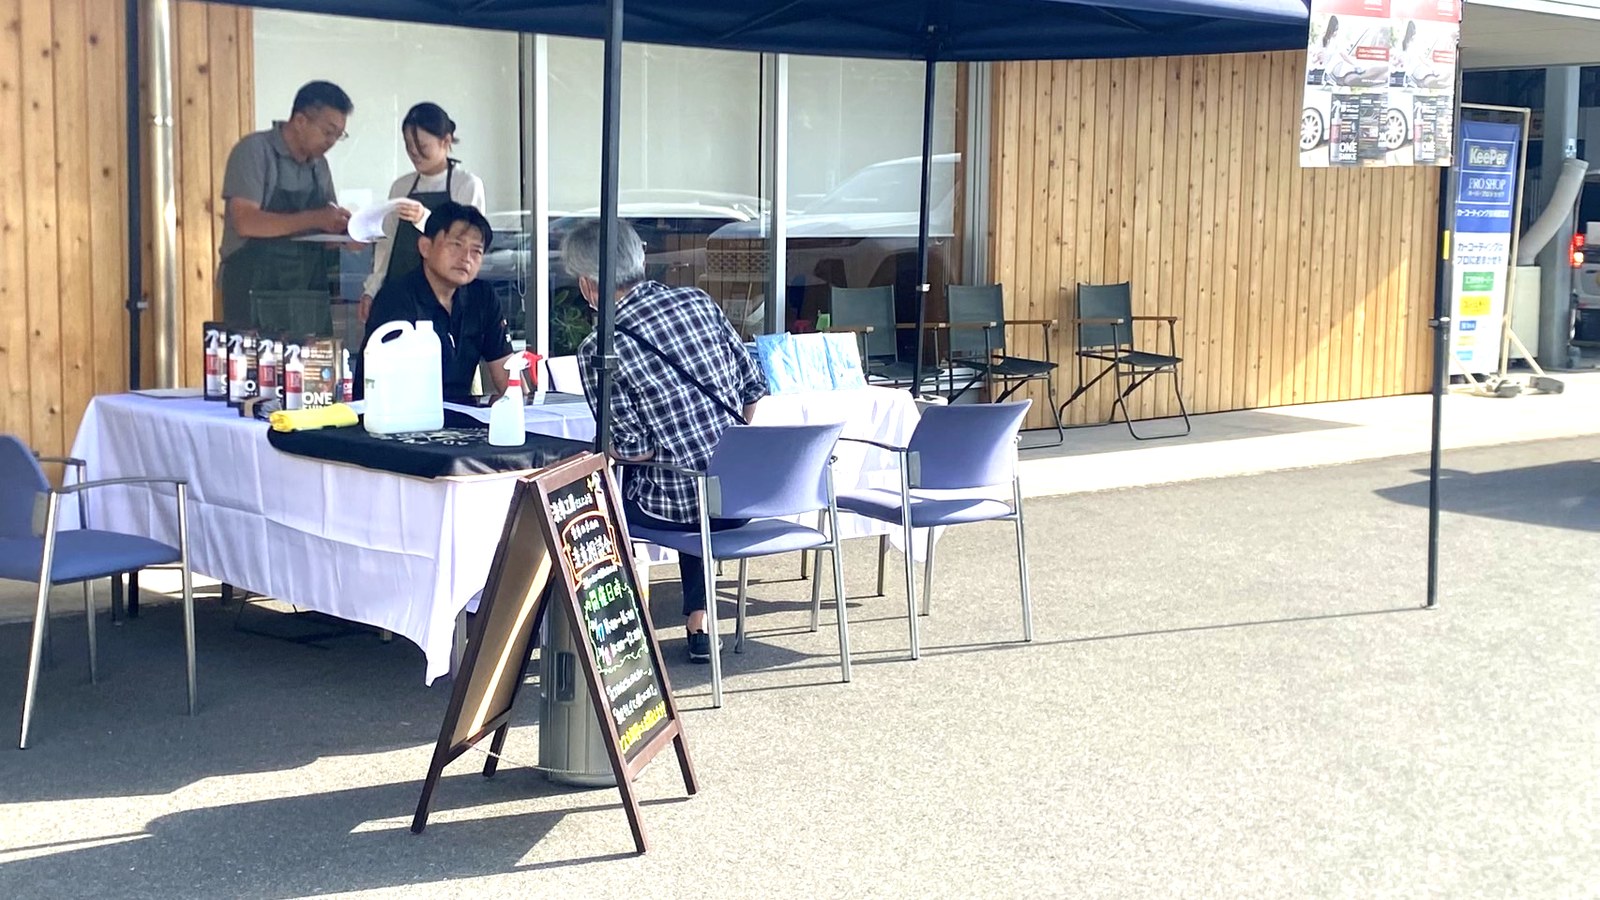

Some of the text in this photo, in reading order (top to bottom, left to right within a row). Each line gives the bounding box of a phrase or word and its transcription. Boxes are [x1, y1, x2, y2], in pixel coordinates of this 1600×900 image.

[1469, 146, 1508, 166] KeePer
[1468, 178, 1506, 190] PRO SHOP
[302, 392, 332, 404] ONE
